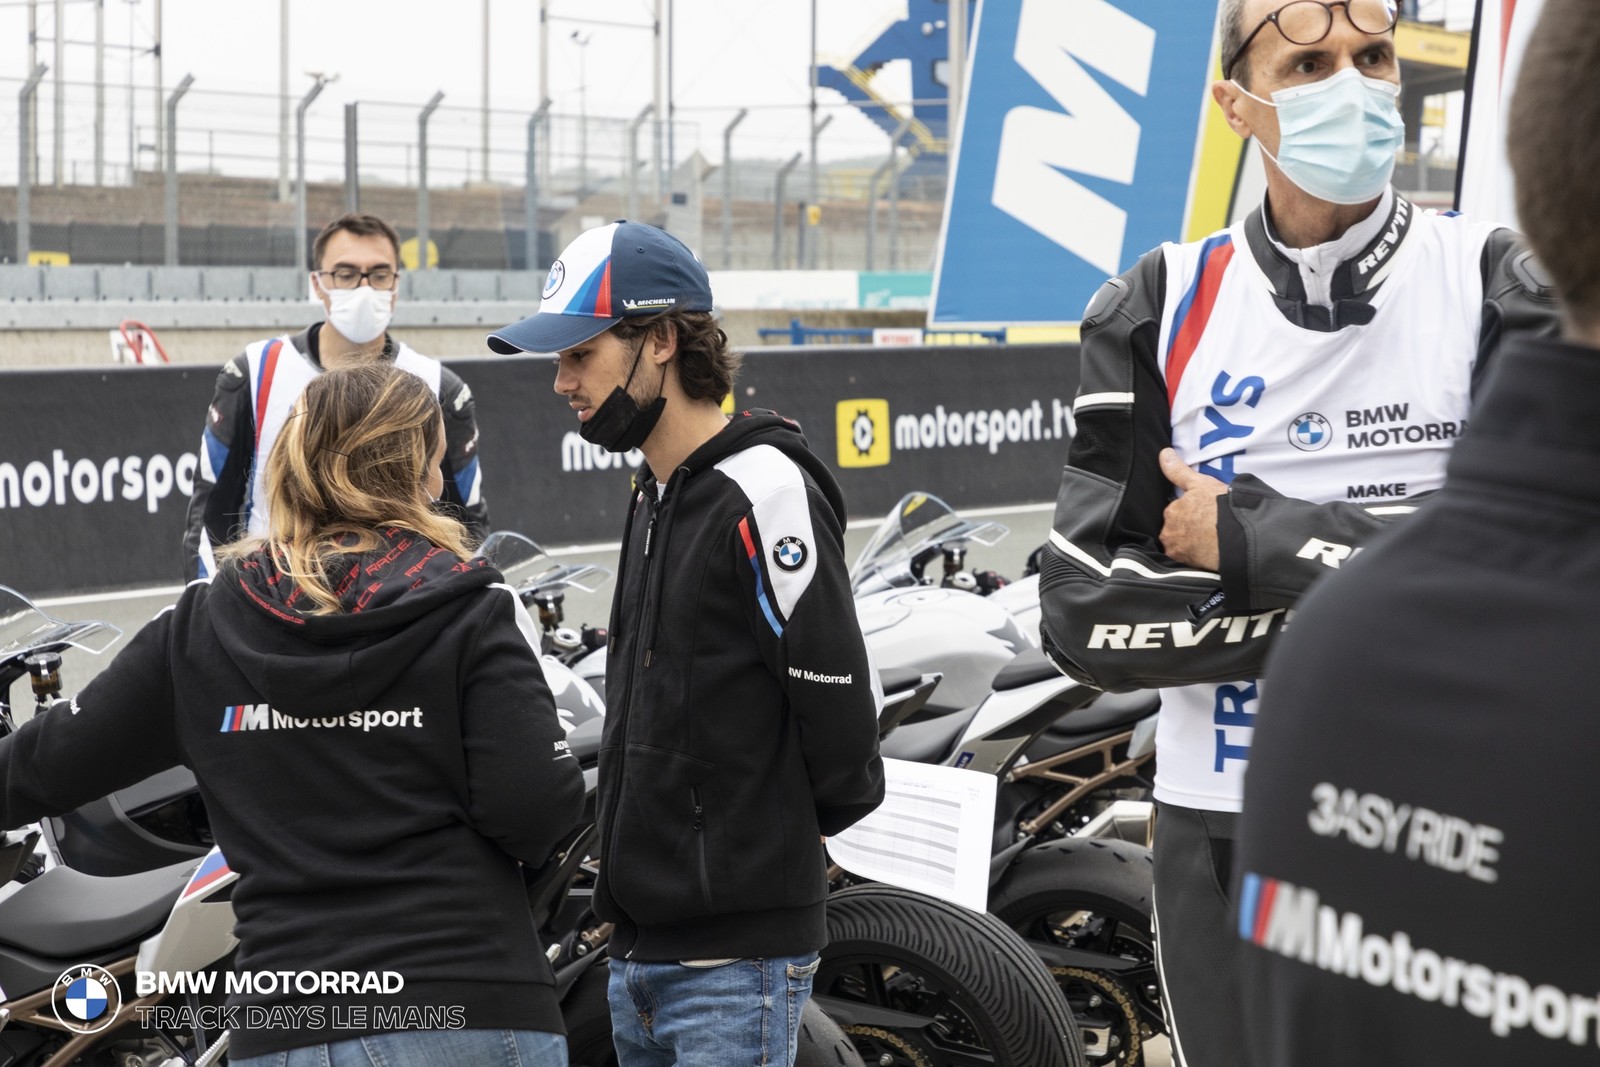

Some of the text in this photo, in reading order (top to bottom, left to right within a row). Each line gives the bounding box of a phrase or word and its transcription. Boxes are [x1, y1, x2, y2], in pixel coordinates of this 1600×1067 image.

[637, 298, 676, 306] MICHELIN
[1198, 370, 1265, 484] AYS
[1346, 403, 1409, 428] BMW
[1347, 419, 1468, 449] MOTORRA
[1347, 483, 1407, 499] MAKE
[365, 538, 413, 576] RACE
[404, 546, 446, 577] RAC
[803, 670, 852, 685] Motorrad
[1315, 905, 1600, 1050] Motorspor
